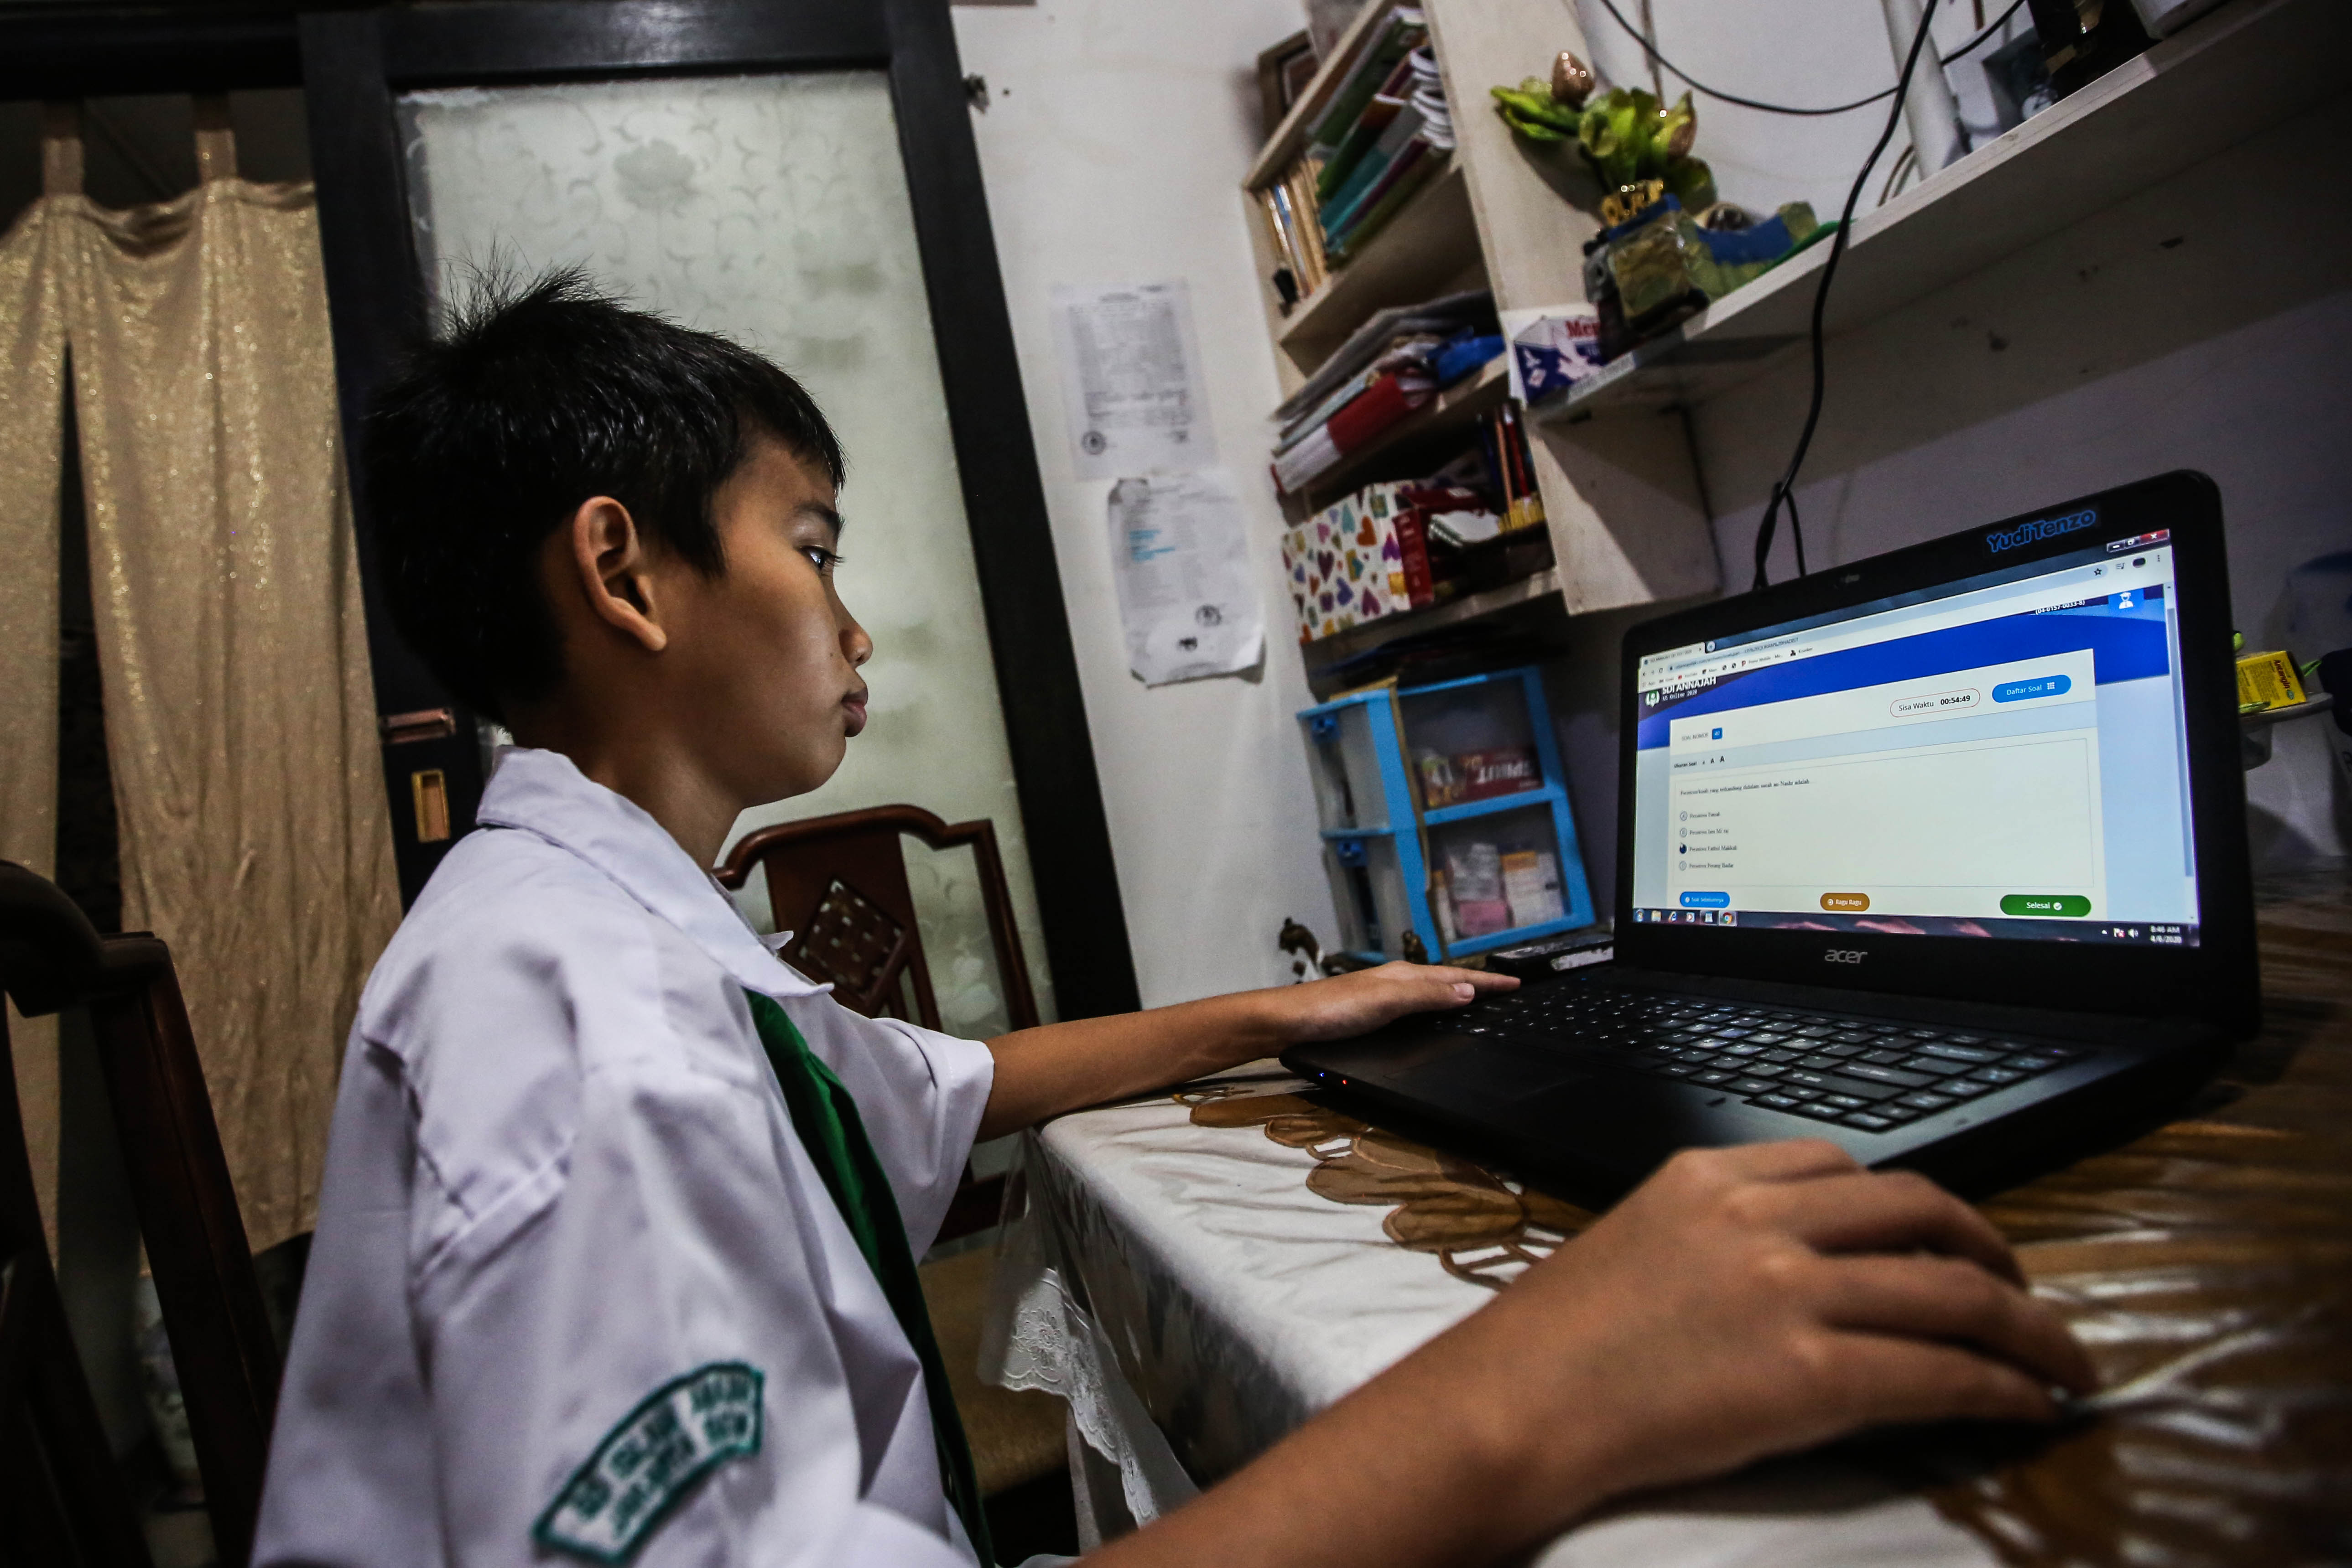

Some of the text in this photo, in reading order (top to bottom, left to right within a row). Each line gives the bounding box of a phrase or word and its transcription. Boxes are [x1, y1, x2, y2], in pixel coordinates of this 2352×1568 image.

[2006, 684, 2042, 696] Daftar Soal
[1913, 700, 1934, 709] Waktu
[1940, 695, 1971, 706] 00:54:49
[2026, 901, 2050, 909] Selesai
[2166, 925, 2180, 934] AM
[1825, 949, 1868, 964] acer
